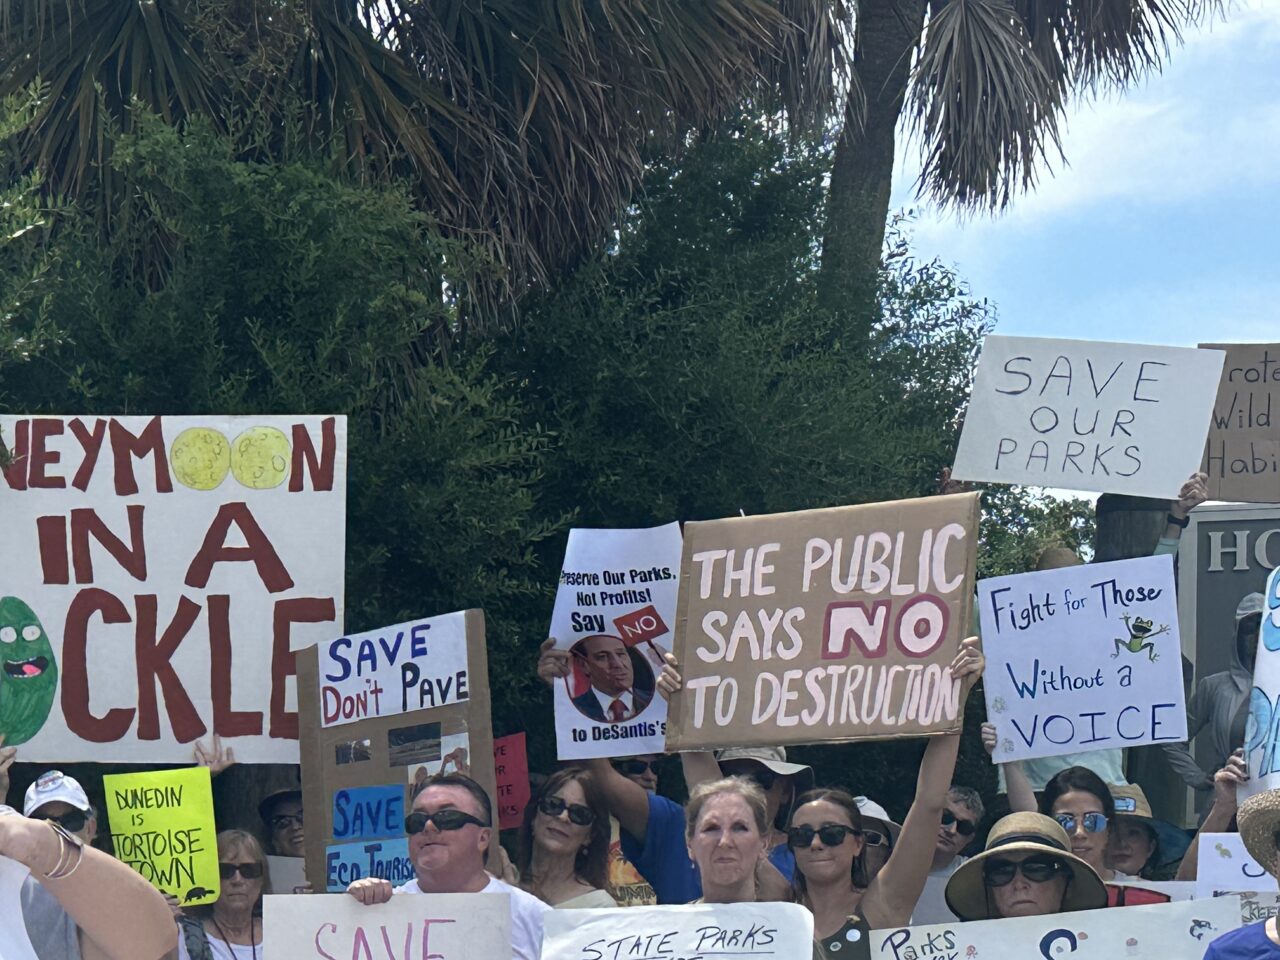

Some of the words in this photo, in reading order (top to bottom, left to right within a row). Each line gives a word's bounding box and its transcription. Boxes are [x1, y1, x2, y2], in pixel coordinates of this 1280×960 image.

[995, 355, 1170, 402] SAVE
[1030, 406, 1135, 437] OUR
[995, 438, 1141, 476] PARKS
[37, 505, 146, 584] IN
[185, 502, 294, 593] A
[692, 542, 781, 599] THE
[802, 522, 967, 596] PUBLIC
[576, 591, 597, 607] Not
[600, 588, 652, 606] Profits!
[603, 570, 625, 586] Our
[571, 612, 606, 633] Say
[622, 615, 657, 638] NO
[990, 587, 1056, 634] Fight
[1064, 588, 1088, 615] for
[1091, 579, 1163, 618] Those
[696, 606, 806, 663] SAYS
[822, 593, 950, 660] NO
[325, 624, 431, 682] SAVE
[401, 662, 468, 712] PAVE
[686, 675, 738, 729] TO
[751, 663, 962, 727] DESTRUCTION
[1006, 659, 1104, 700] Without
[1118, 665, 1132, 687] a
[572, 727, 587, 743] to
[1011, 703, 1181, 748] VOICE
[115, 785, 183, 810] DUNEDIN
[333, 790, 402, 837] SAVE
[132, 813, 144, 826] IS
[111, 828, 204, 860] TORTOISE
[124, 856, 195, 888] TOWN
[695, 923, 777, 952] PARKS
